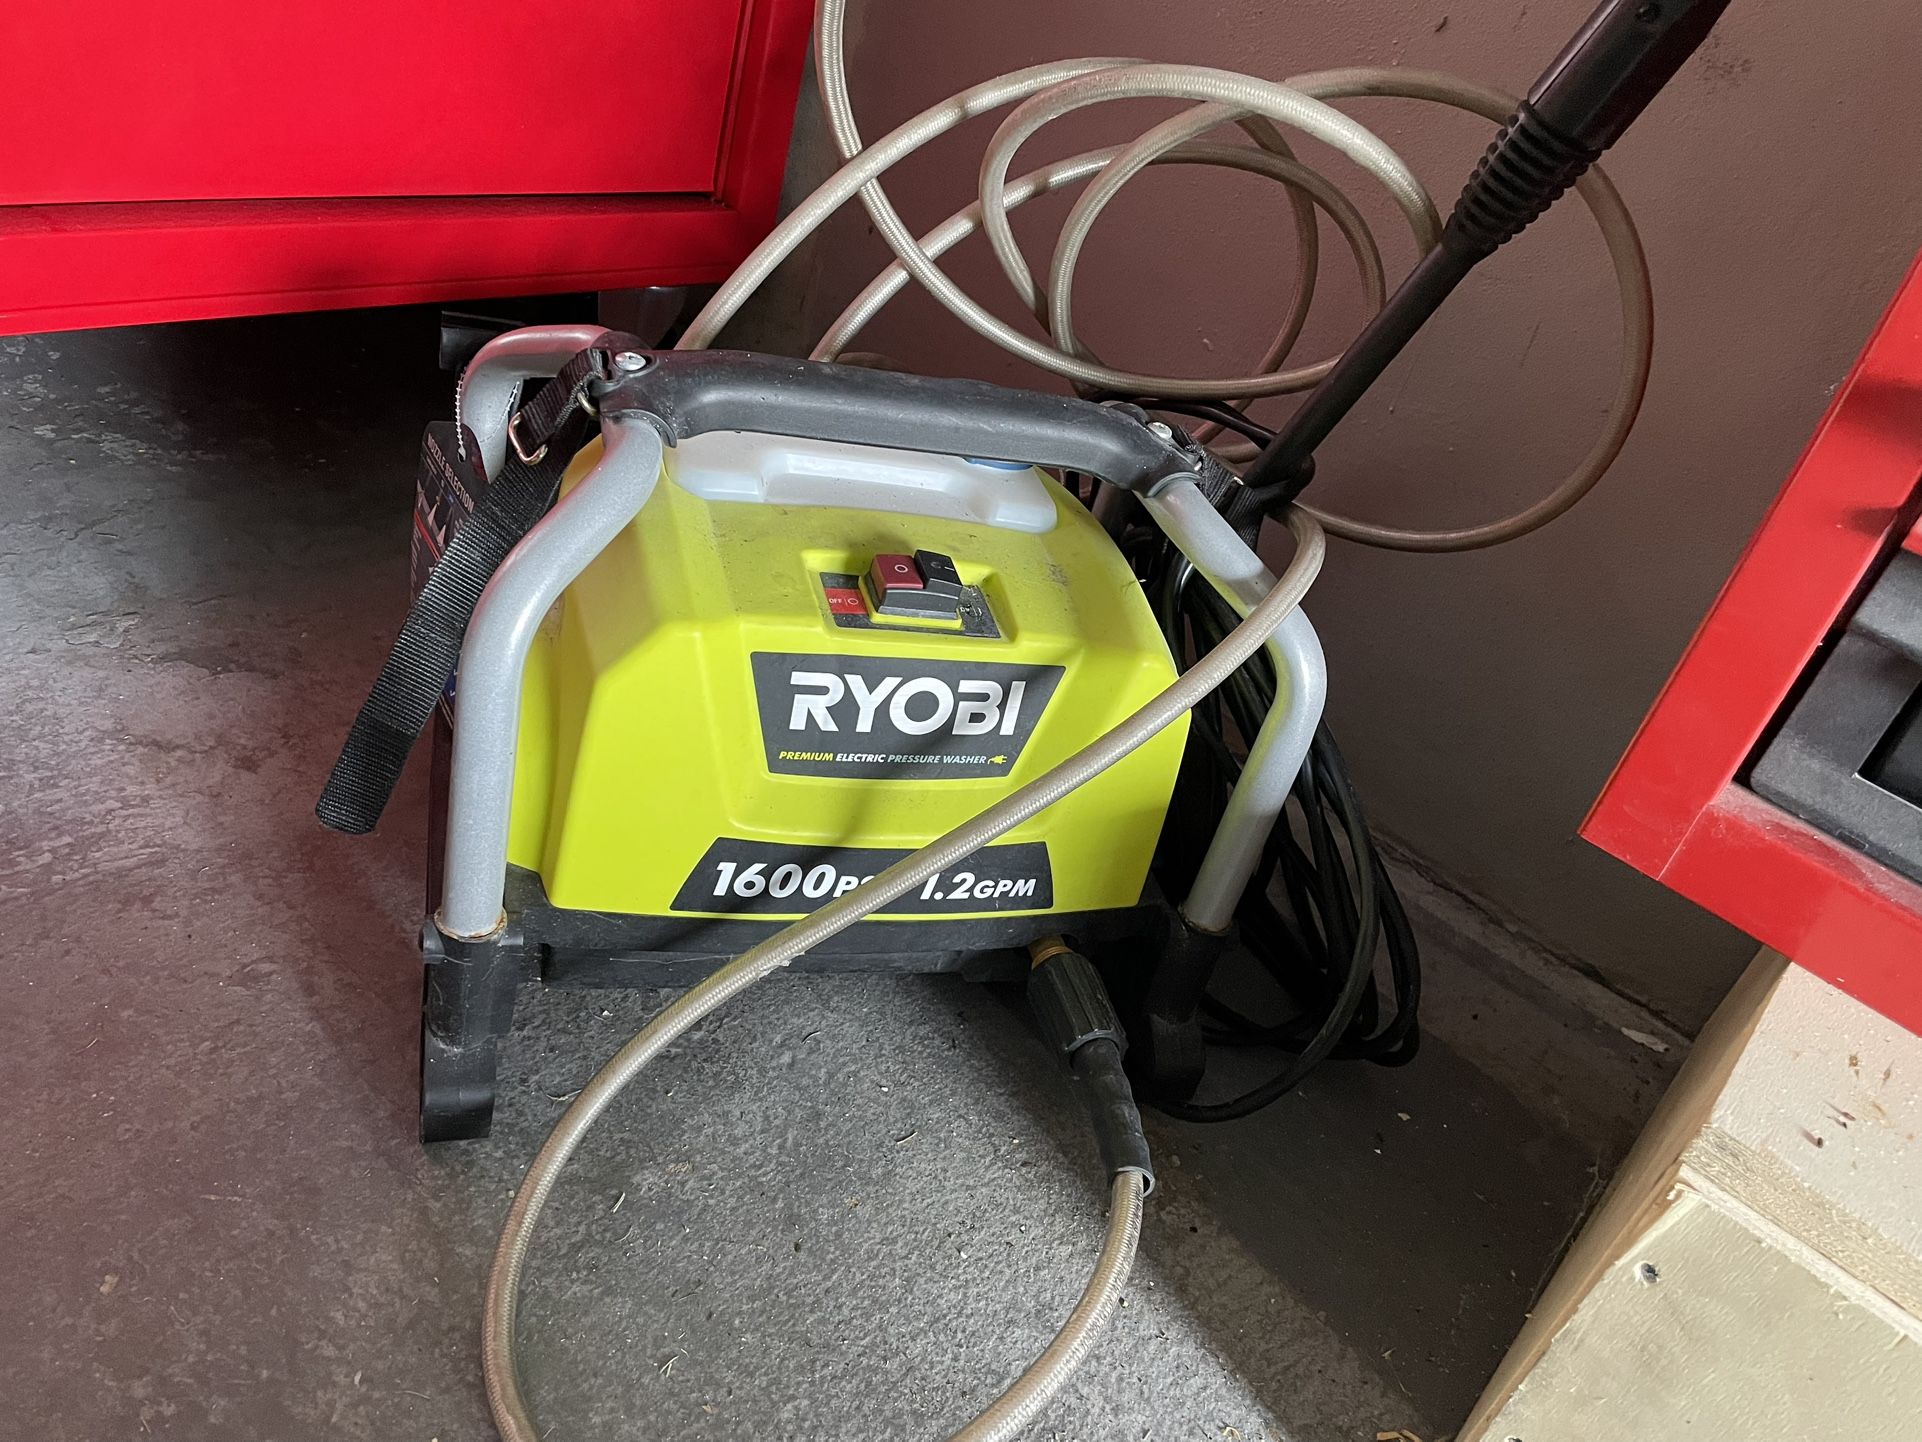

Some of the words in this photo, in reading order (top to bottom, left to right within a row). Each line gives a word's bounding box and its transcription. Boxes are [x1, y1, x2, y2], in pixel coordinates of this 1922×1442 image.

[444, 463, 475, 514] SELECTION
[789, 671, 1027, 735] RYOBI
[779, 751, 834, 762] PREMIUM
[836, 753, 886, 763] ELECTRIC
[887, 754, 941, 764] PRESSURE
[943, 755, 987, 764] WASHER
[711, 861, 875, 899] 1600P
[920, 872, 1037, 901] 1.2GPM
